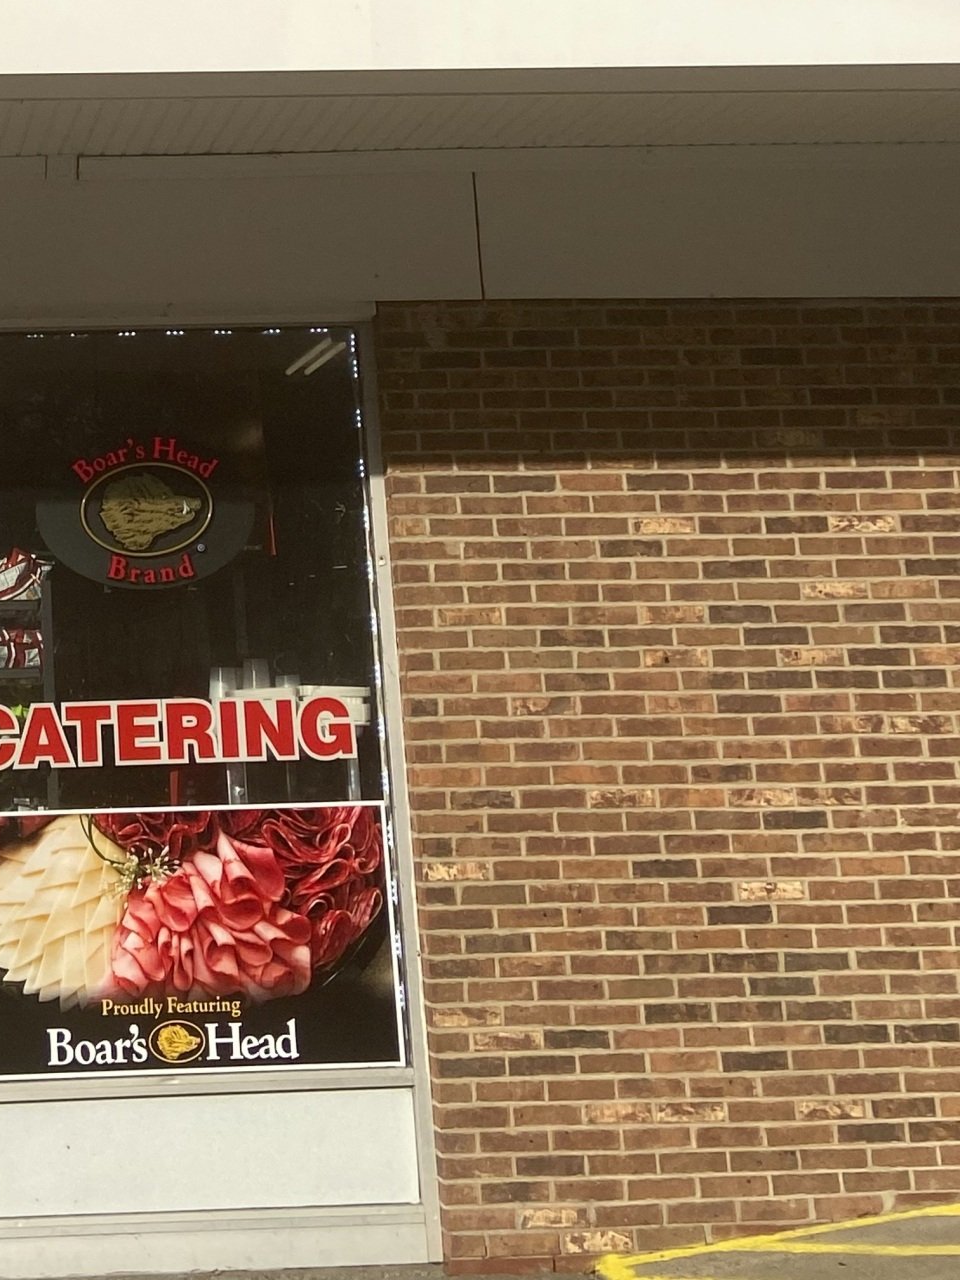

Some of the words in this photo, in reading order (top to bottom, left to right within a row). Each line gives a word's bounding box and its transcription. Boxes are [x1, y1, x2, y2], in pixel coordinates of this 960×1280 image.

[72, 439, 145, 482] Boar's
[152, 436, 220, 479] Head
[106, 554, 195, 584] Brand
[101, 998, 163, 1019] Proudly
[167, 995, 242, 1018] Featuring
[47, 1025, 148, 1066] Boar's
[205, 1018, 300, 1061] Head
